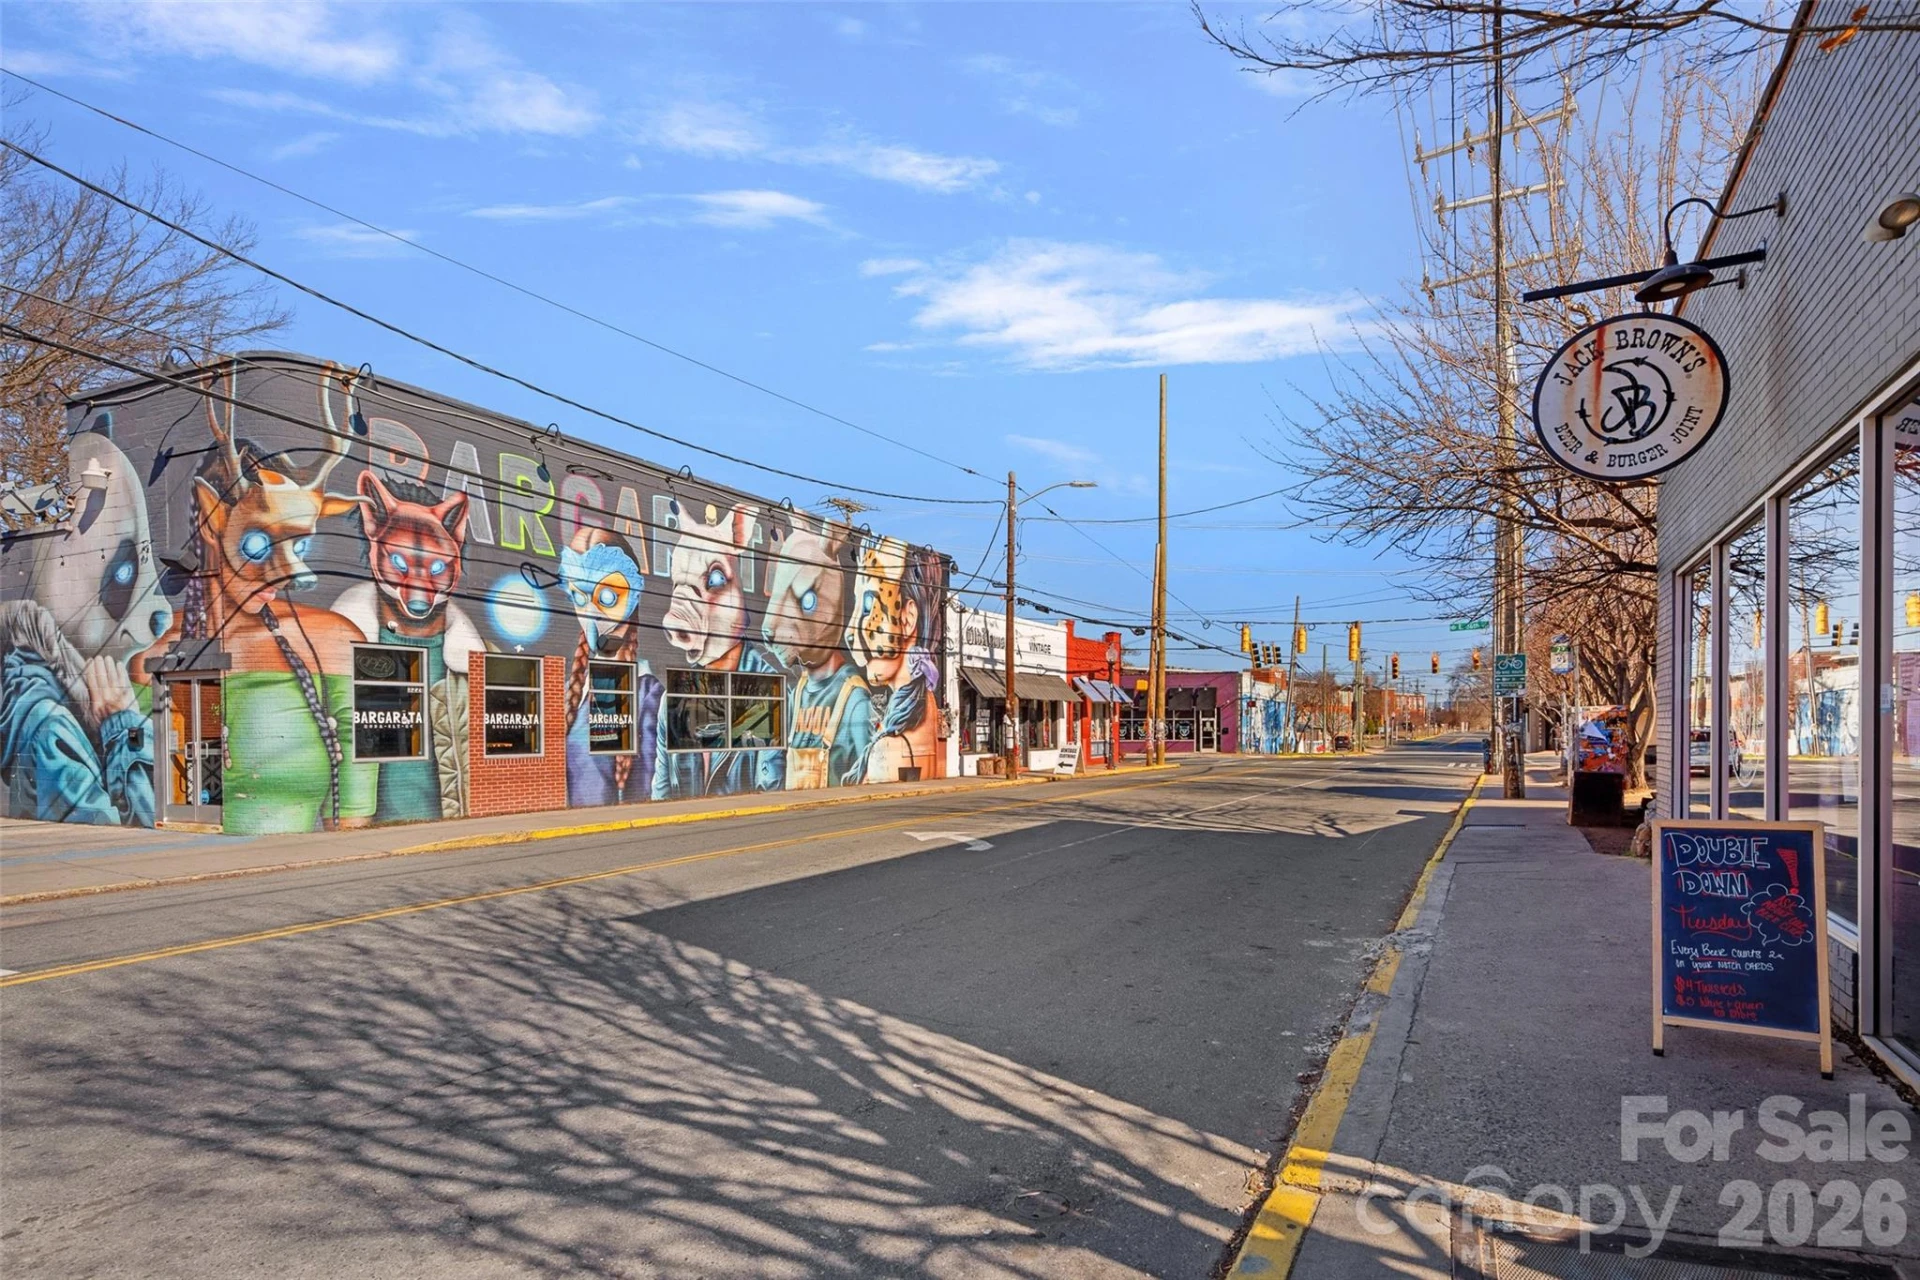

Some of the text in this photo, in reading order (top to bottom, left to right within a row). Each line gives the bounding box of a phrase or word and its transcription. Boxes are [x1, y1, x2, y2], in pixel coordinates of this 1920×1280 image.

[1553, 327, 1708, 387] JACK BROWN'S
[1554, 405, 1704, 468] BEER & BURGER JOINT
[1028, 642, 1051, 654] VINTAGE
[1664, 832, 1770, 869] DOUBLE
[1672, 870, 1748, 897] DOWN
[1670, 904, 1752, 938] Tuesday
[1671, 939, 1699, 960] Every
